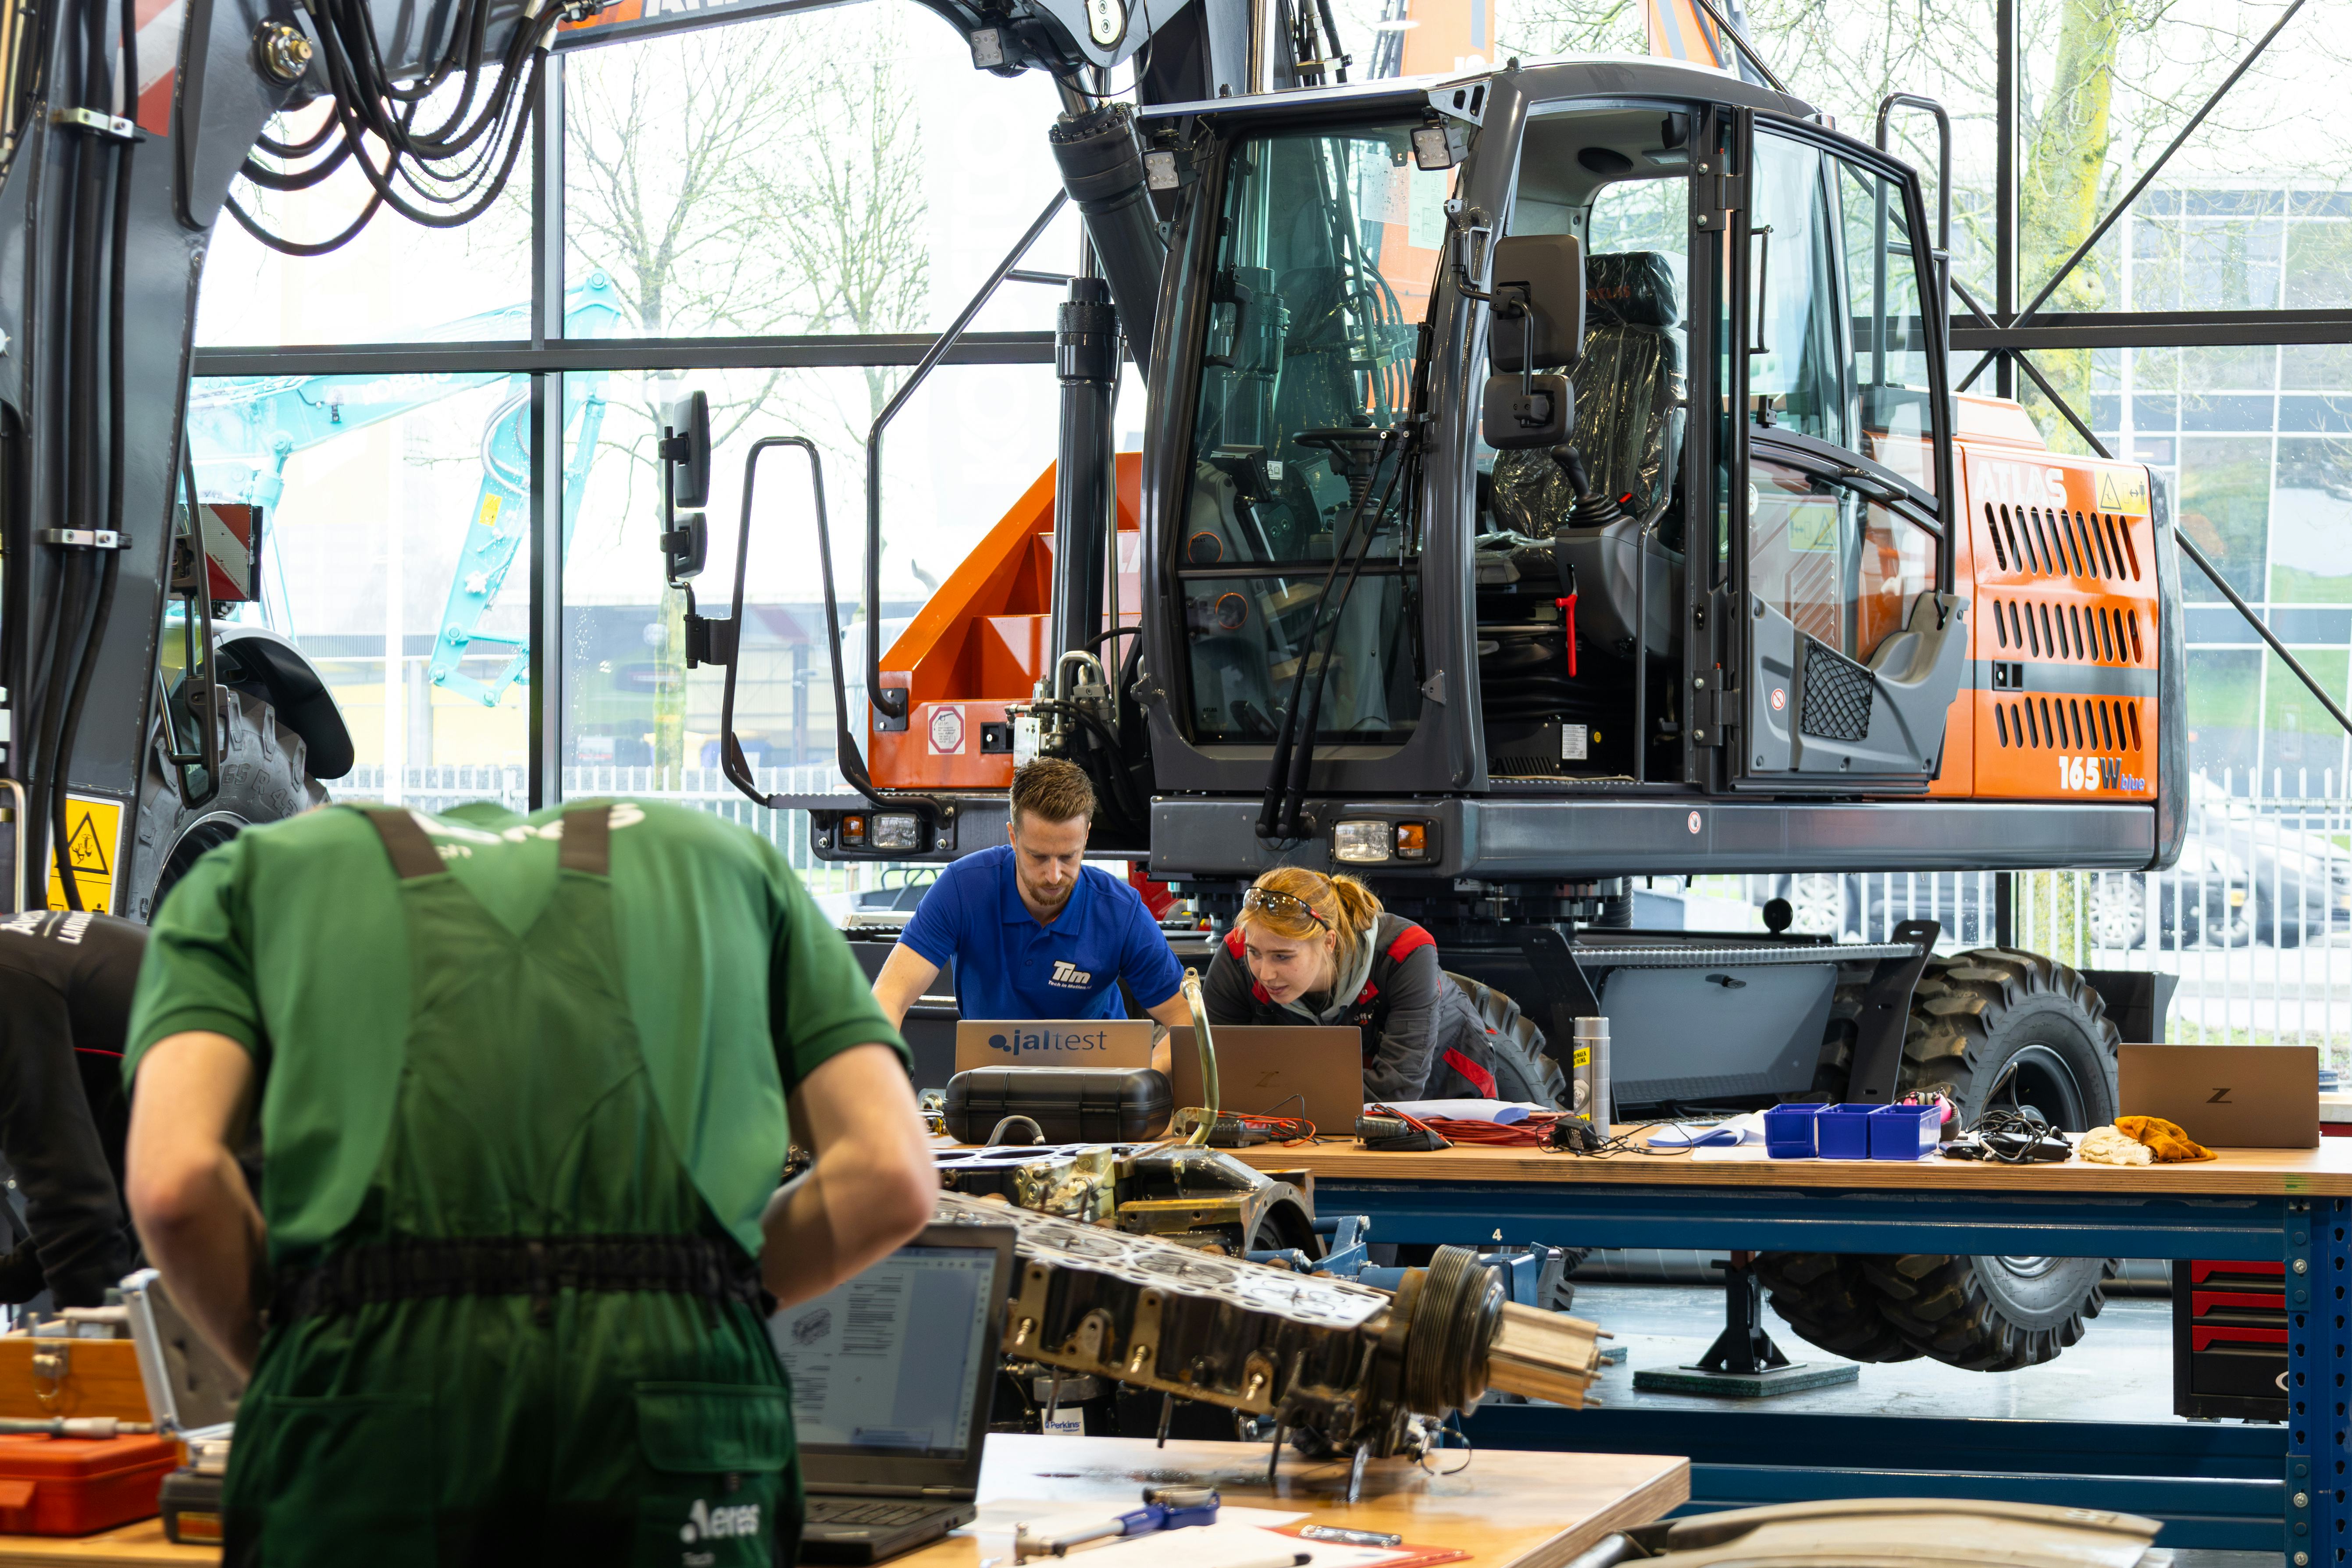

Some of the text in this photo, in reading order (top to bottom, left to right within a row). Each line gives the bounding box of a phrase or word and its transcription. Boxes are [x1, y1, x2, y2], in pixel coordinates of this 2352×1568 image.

[1974, 460, 2067, 508] ATLAS
[1052, 960, 1091, 984] Tim
[1013, 1029, 1107, 1055] jaltest
[2206, 1088, 2232, 1104] Z
[1492, 1228, 1502, 1241] 4
